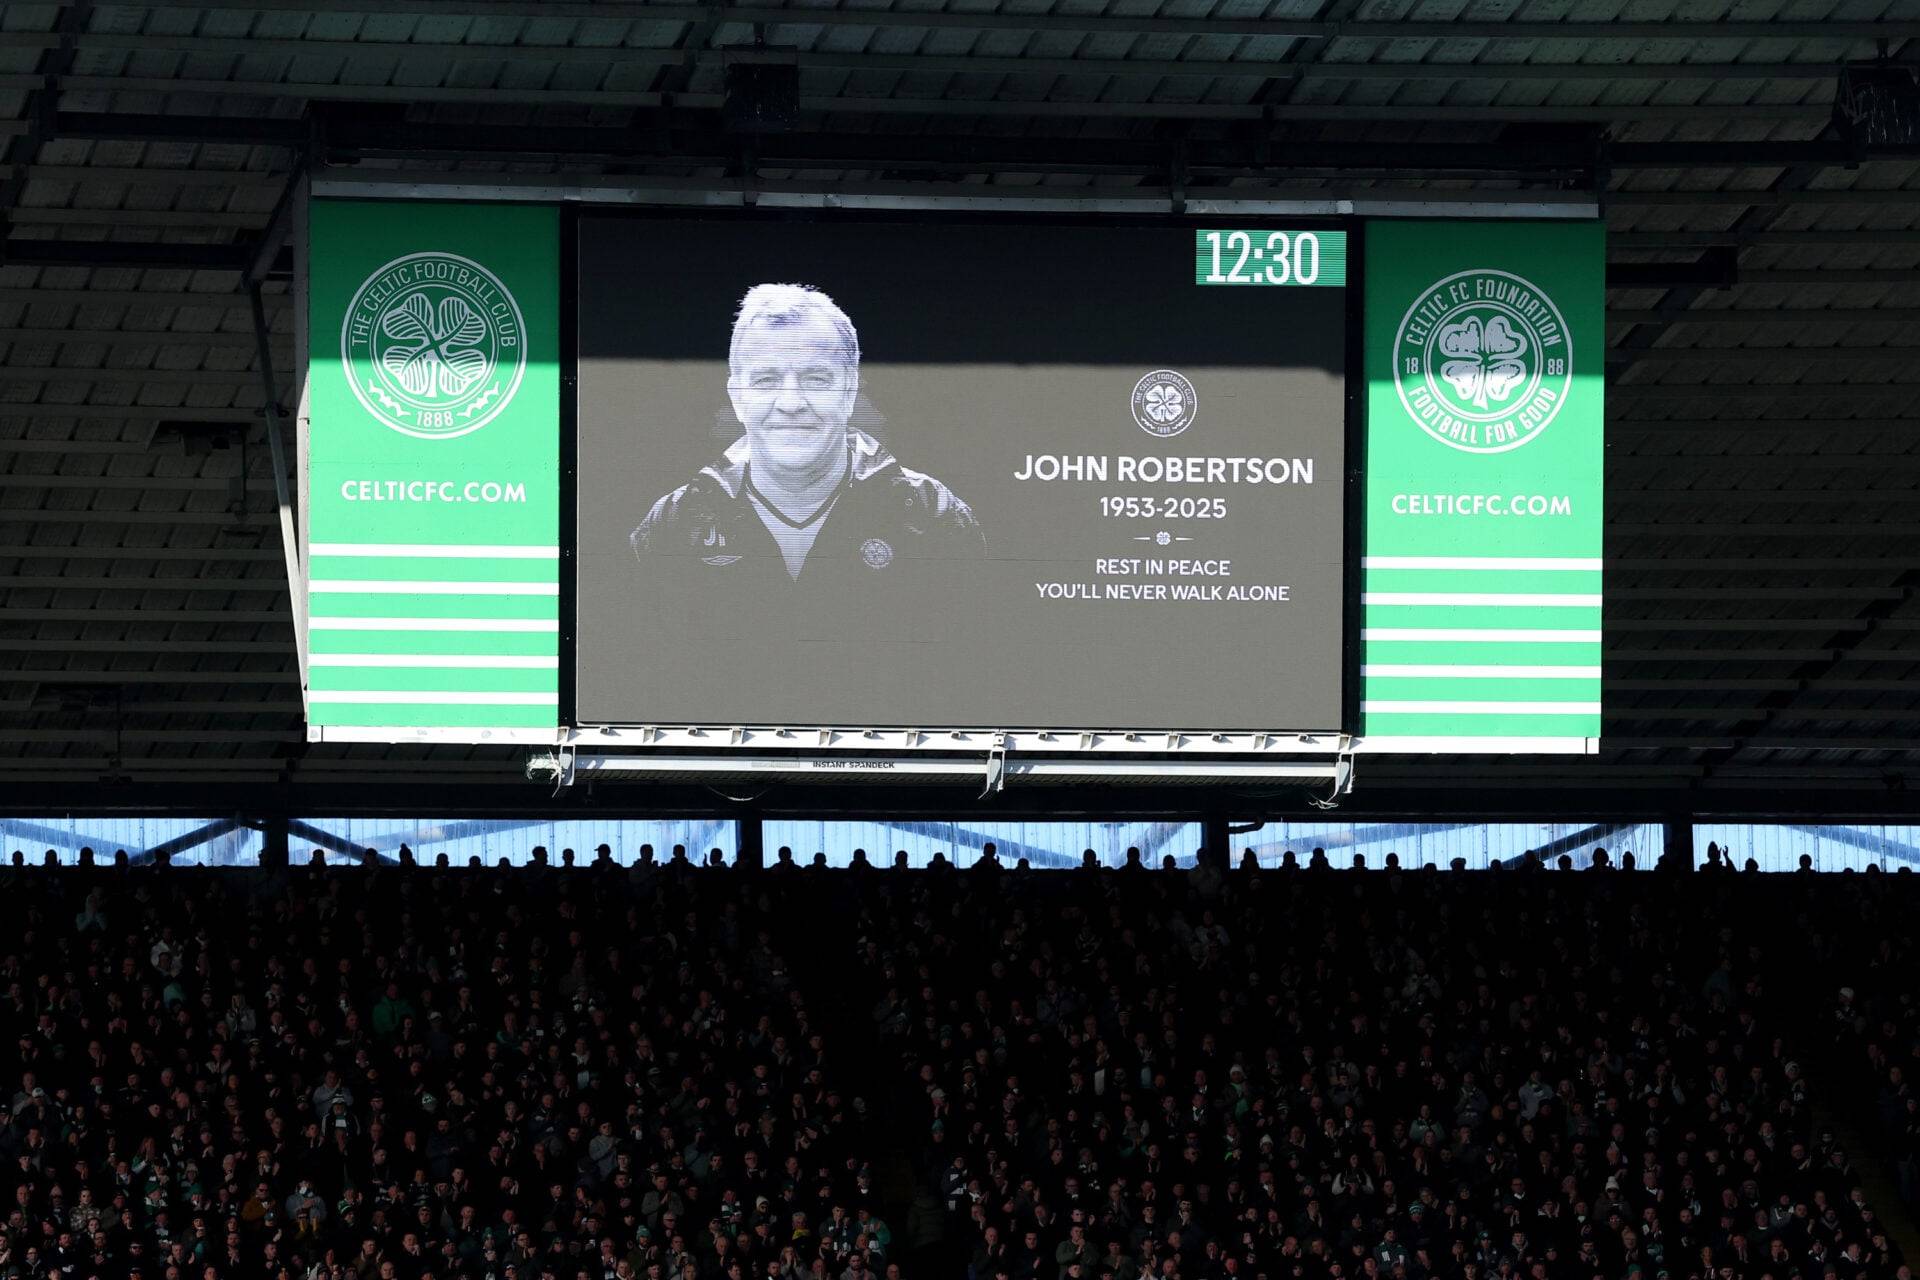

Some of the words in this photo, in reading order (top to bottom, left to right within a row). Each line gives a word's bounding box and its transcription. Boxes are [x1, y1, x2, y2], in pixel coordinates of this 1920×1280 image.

[1206, 231, 1319, 285] 12:30
[351, 312, 373, 347] THE
[363, 268, 411, 312] CELTIC
[414, 262, 497, 304] FOOTBALL
[491, 302, 516, 347] CLUB
[1406, 294, 1448, 346] CELTIC
[1450, 281, 1470, 303] FC
[1477, 279, 1562, 347] FOUNDATION
[1405, 357, 1419, 374] 18
[1548, 358, 1564, 376] 88
[416, 410, 454, 427] 1888
[1408, 385, 1478, 444] FOOTBALL
[1485, 425, 1519, 444] FOR
[1519, 387, 1557, 430] GOOD
[1014, 455, 1107, 481] JOHN
[1118, 456, 1314, 484] ROBERTSON
[341, 480, 527, 503] CELTICFC.COM
[1100, 496, 1227, 519] 1953-2025
[1391, 494, 1572, 516] CELTICFC.COM
[1096, 559, 1141, 575] REST
[1146, 559, 1164, 575] IN
[1168, 560, 1231, 576] PEACE
[1036, 583, 1101, 599] YOU'LL
[1106, 584, 1167, 600] NEVER
[1171, 585, 1222, 601] WALK
[1227, 586, 1290, 601] ALONE
[813, 760, 846, 768] INSTANT
[849, 761, 895, 769] SPANDECK
